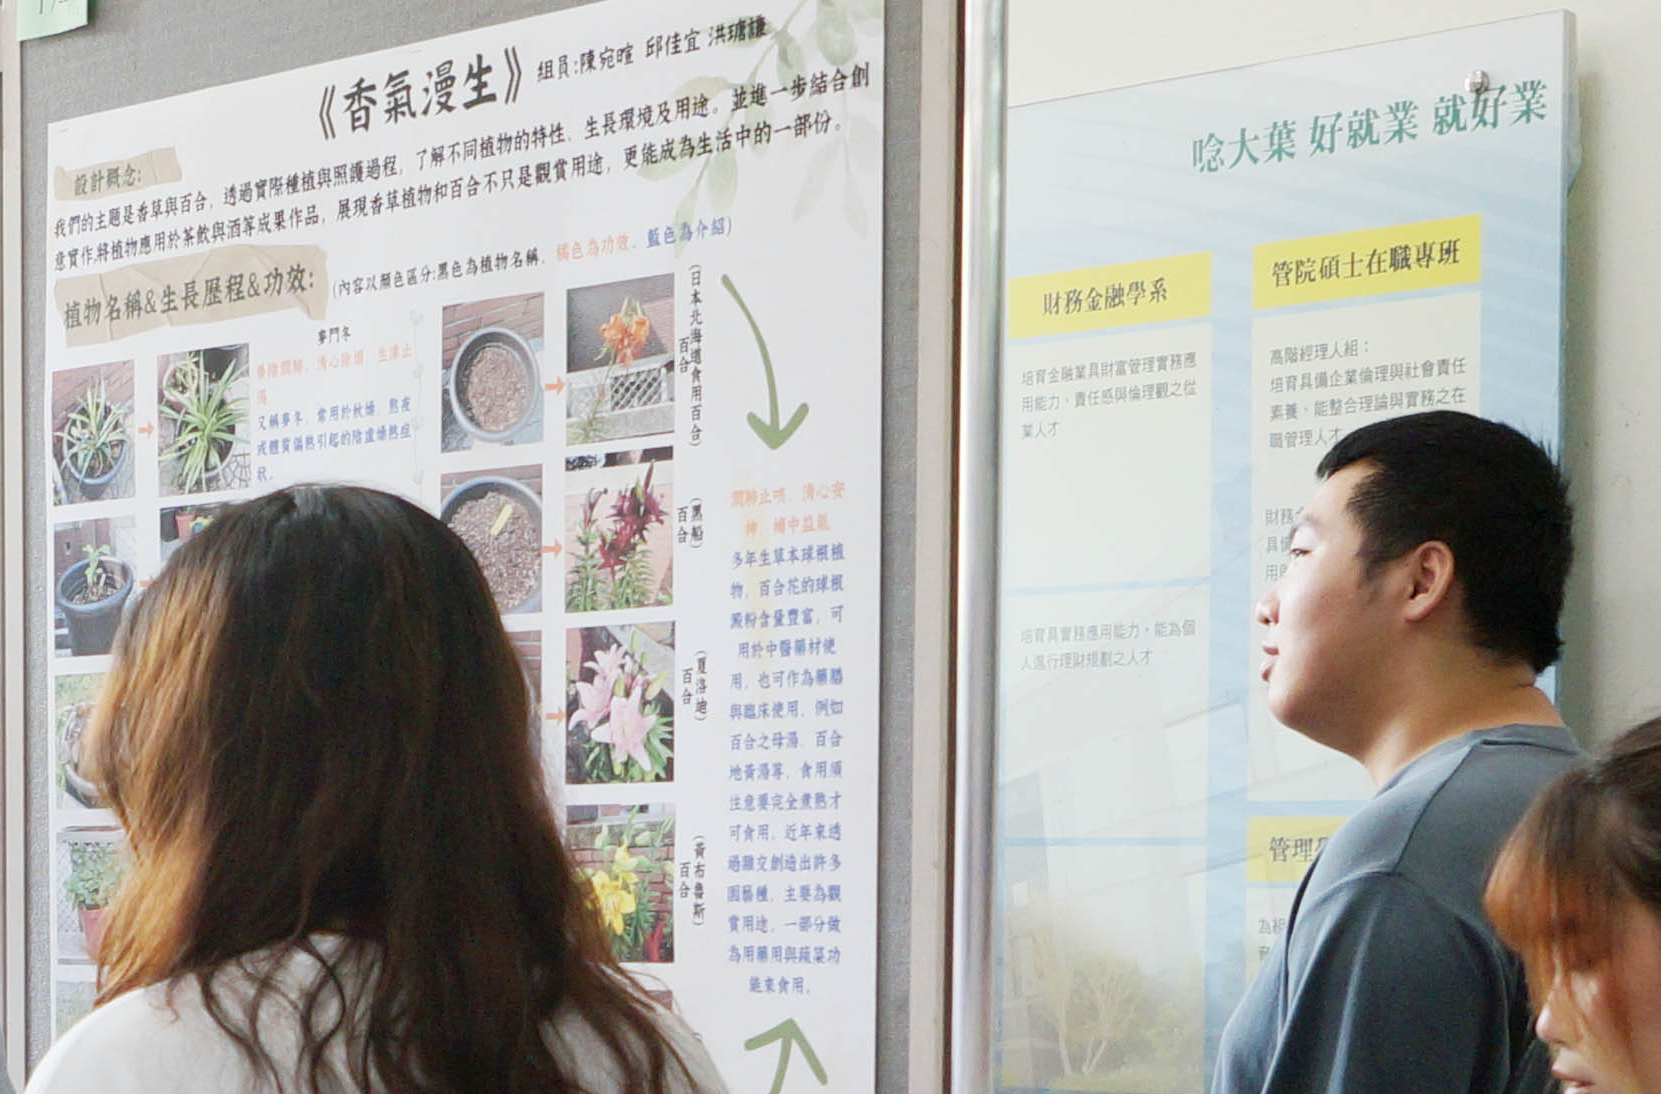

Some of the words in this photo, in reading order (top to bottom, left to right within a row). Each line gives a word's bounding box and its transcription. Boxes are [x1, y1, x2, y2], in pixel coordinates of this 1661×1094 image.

[319, 45, 522, 140] 《香氣漫生》
[1192, 119, 1295, 174] 唸大葉
[1309, 99, 1418, 157] 好就業
[1433, 79, 1547, 136] 就好業
[1272, 237, 1461, 289] 管院碩士在職專班
[1042, 277, 1168, 317] 財務金融學系
[1270, 357, 1466, 394] 培育具備企業倫理與社會責任
[1022, 421, 1060, 439] 業人才
[676, 506, 688, 544] 百合
[682, 668, 693, 705] 百合
[679, 862, 690, 899] 百合
